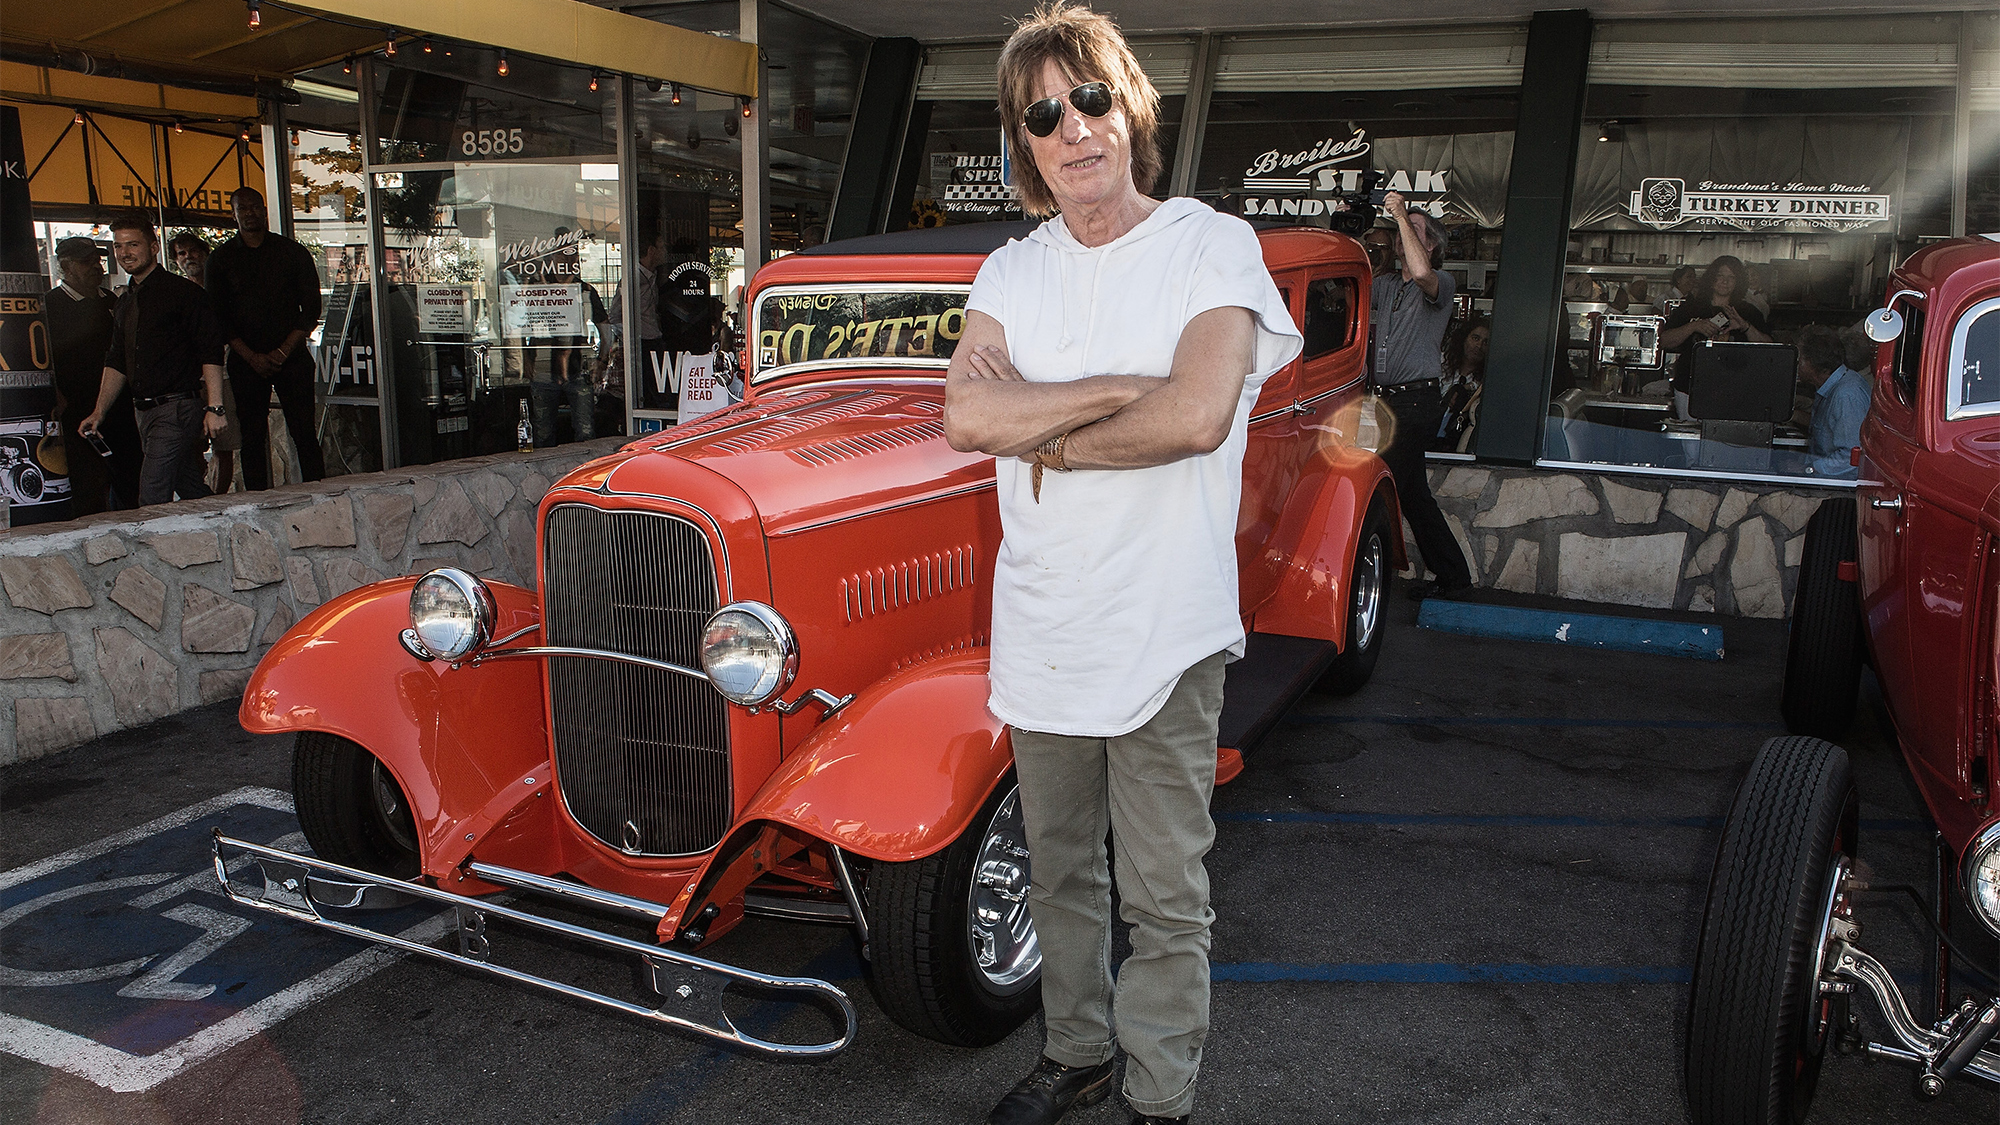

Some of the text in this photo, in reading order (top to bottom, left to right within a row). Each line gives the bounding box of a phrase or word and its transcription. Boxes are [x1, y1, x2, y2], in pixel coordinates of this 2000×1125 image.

[462, 128, 524, 156] 8585
[1245, 129, 1371, 177] Broiled
[956, 155, 1002, 168] BLUE
[0, 160, 25, 180] K.
[1699, 180, 1871, 193] Grandma's Home Made
[963, 201, 1001, 215] Change
[1243, 198, 1446, 218] SANDWS
[1688, 197, 1881, 215] TURKEY DINNER
[1701, 218, 1734, 226] SERVED
[499, 228, 584, 263] Welcome
[518, 261, 537, 275] TO
[689, 280, 698, 288] 24
[515, 289, 549, 297] CLOSED
[424, 298, 448, 306] PRIVATE
[510, 298, 574, 307] PRIVATE EVENT
[689, 366, 706, 378] EAT
[687, 378, 717, 389] SLEEP
[687, 390, 713, 401] READ
